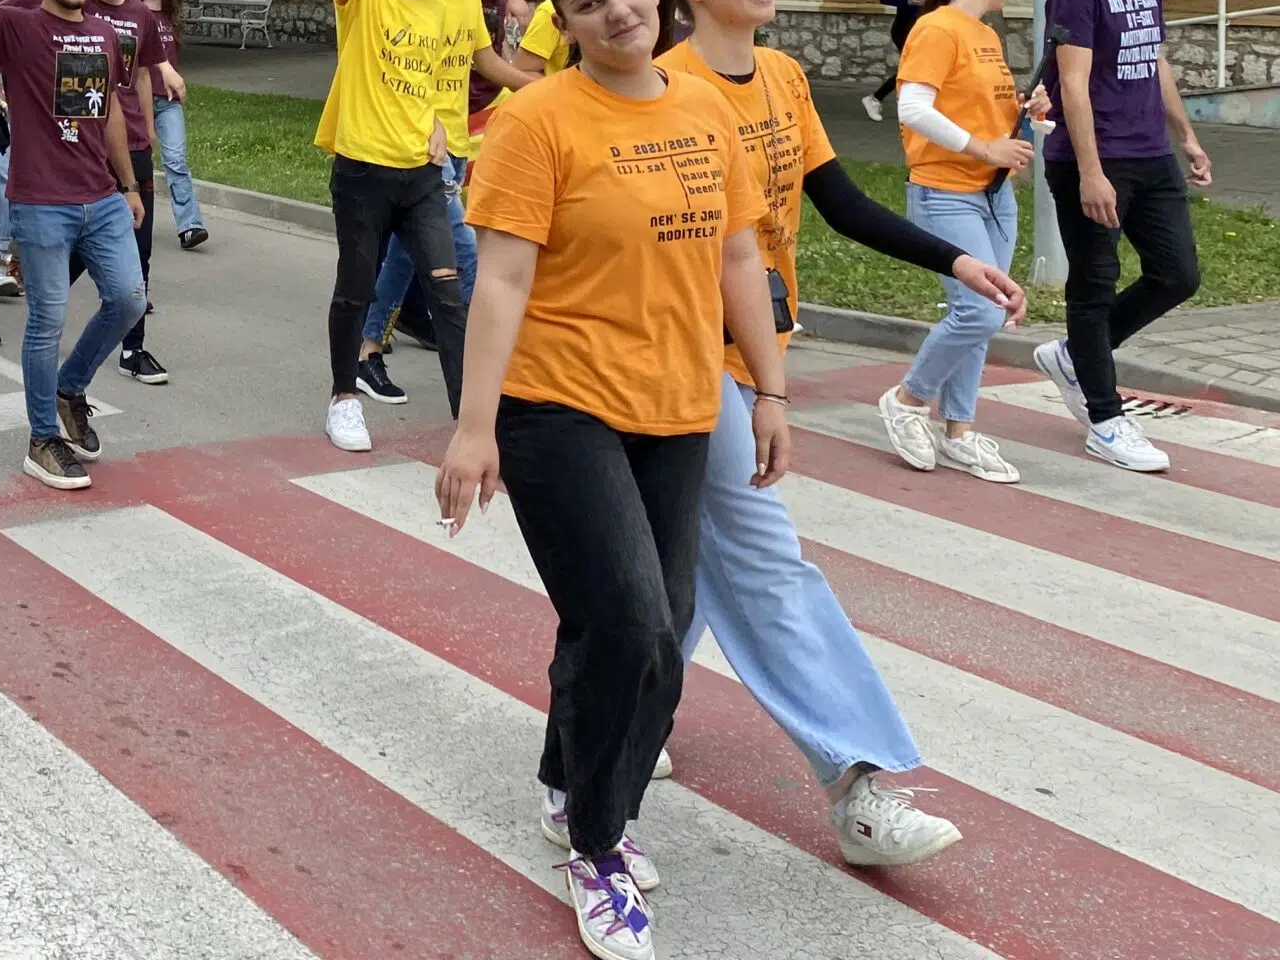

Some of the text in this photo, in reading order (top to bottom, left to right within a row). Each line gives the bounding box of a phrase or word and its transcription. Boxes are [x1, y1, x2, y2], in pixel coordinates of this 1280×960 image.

[610, 134, 715, 158] D 2021/2025 P
[647, 161, 667, 173] sat
[676, 156, 710, 168] where
[687, 183, 717, 195] been?
[681, 212, 697, 223] SE
